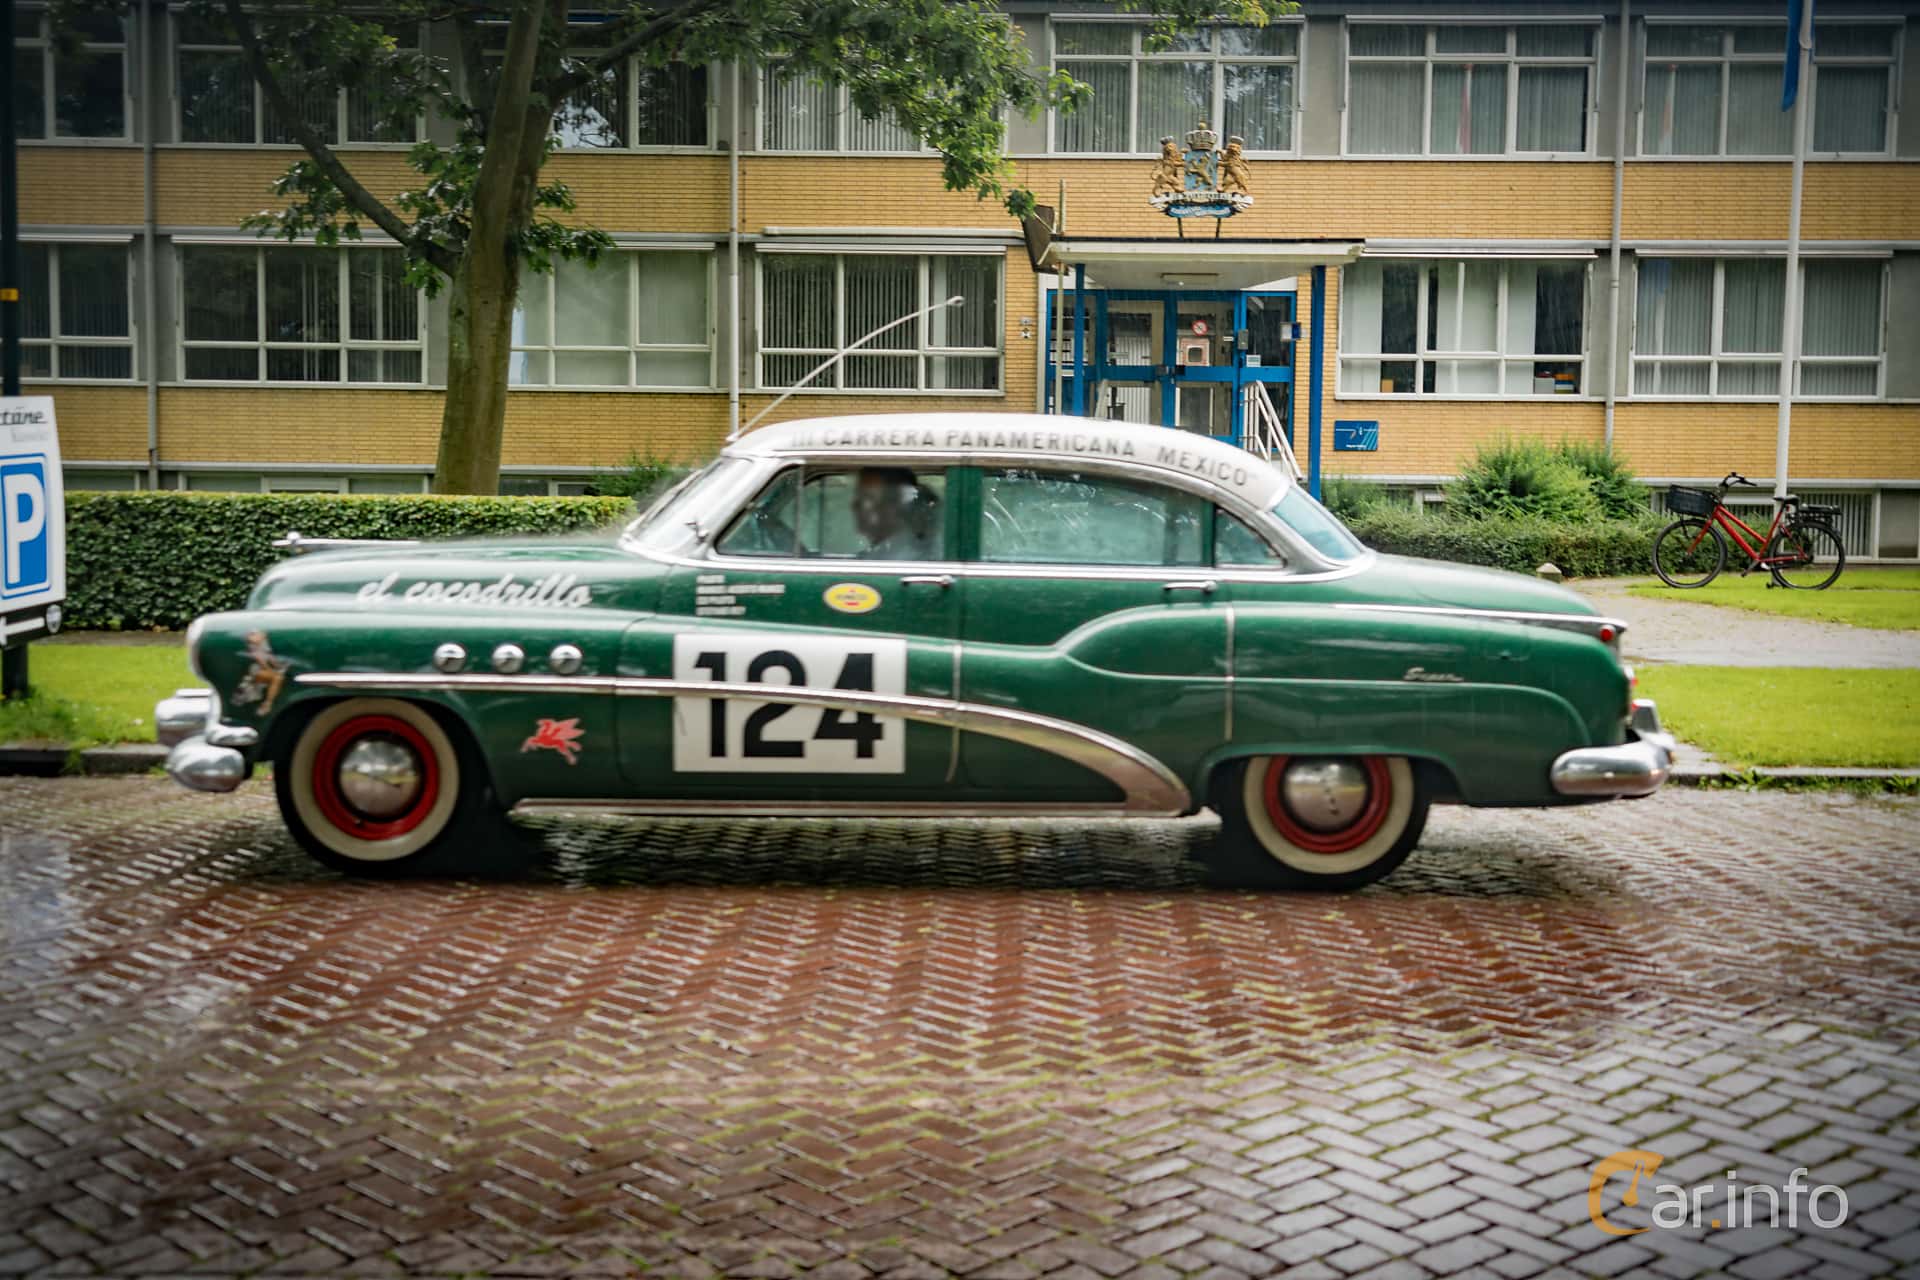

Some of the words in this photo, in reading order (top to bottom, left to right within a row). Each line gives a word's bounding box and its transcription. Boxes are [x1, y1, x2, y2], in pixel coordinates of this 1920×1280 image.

[823, 430, 934, 446] CARRERA
[946, 430, 1134, 456] PANAMERICANA
[4, 473, 45, 584] P
[357, 571, 400, 600] el
[405, 573, 592, 606] cocodrillo
[693, 650, 884, 758] 124
